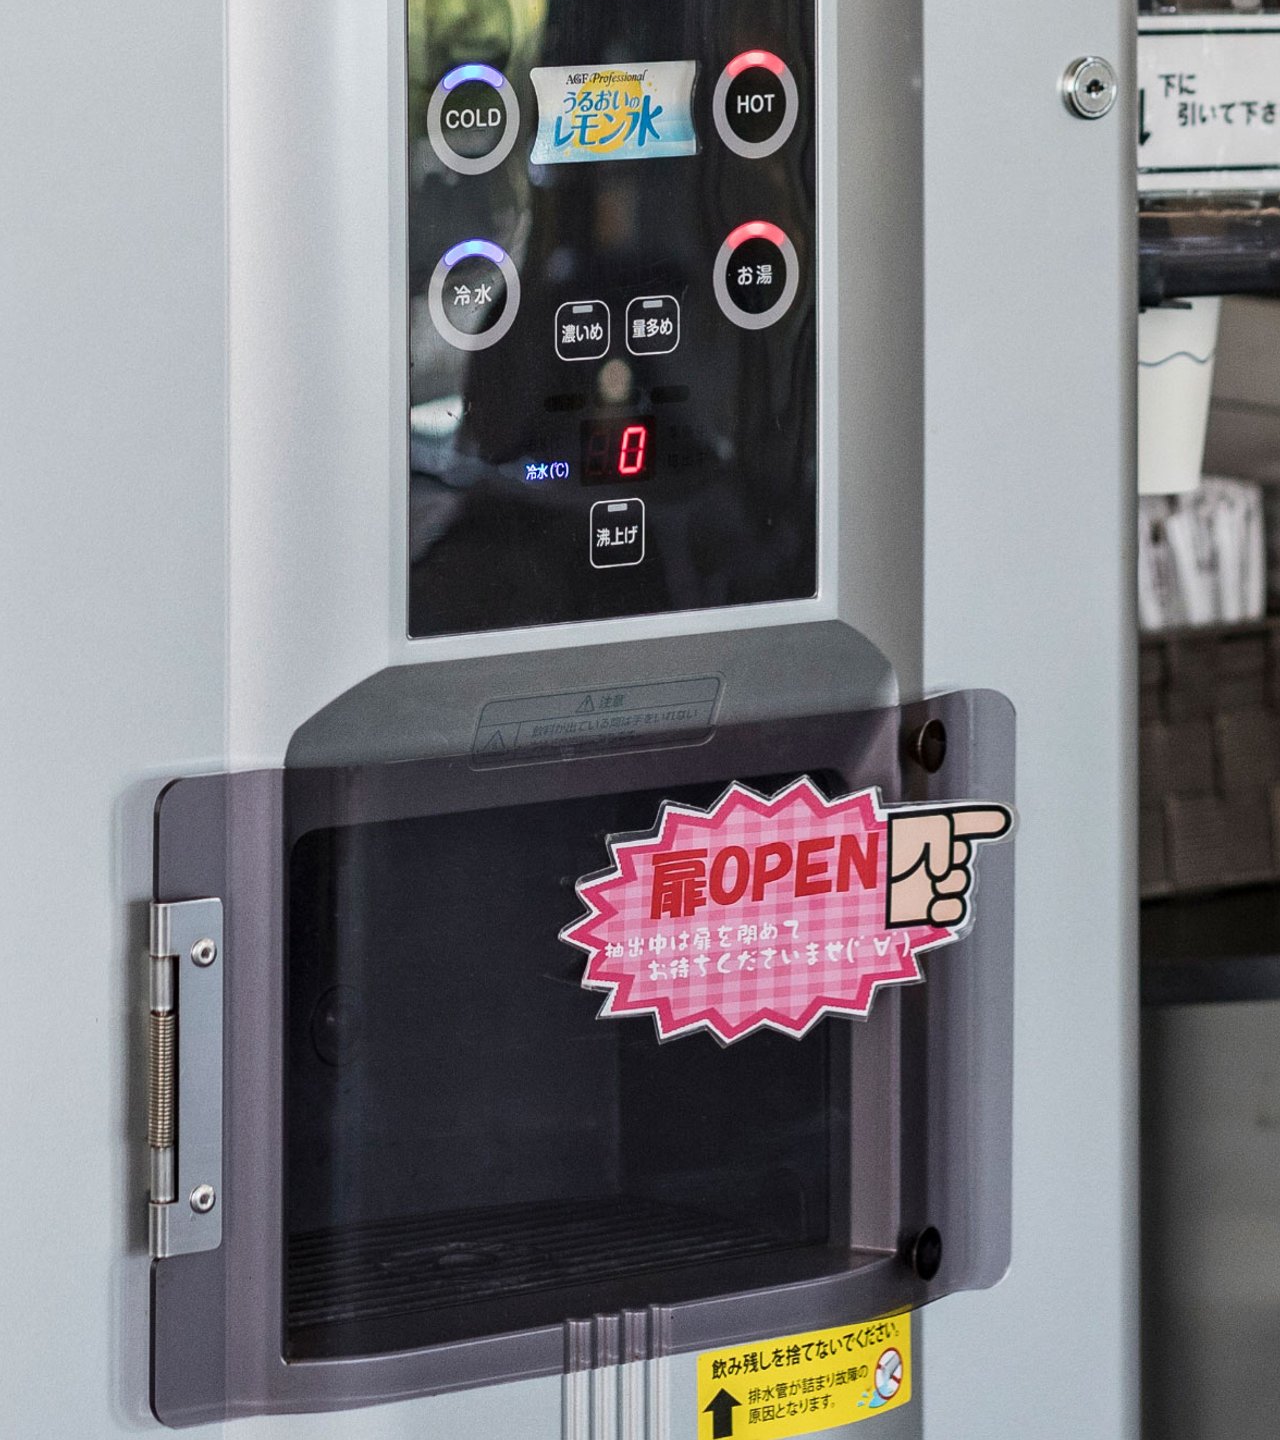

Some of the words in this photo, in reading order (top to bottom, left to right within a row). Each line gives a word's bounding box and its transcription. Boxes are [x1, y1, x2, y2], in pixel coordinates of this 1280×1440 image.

[589, 69, 648, 87] Professional
[1158, 73, 1196, 98] 下に
[563, 90, 640, 114] うるおいの
[737, 94, 775, 114] HOT
[445, 108, 501, 129] COLD
[554, 95, 663, 148] レモン水
[737, 264, 773, 285] お湯
[453, 284, 492, 306] 冷水
[561, 323, 604, 344] 濃いめ
[632, 318, 673, 338] 量多め
[596, 526, 638, 548] 沸上げ
[748, 1363, 869, 1405] 排水管が詰まり故障の
